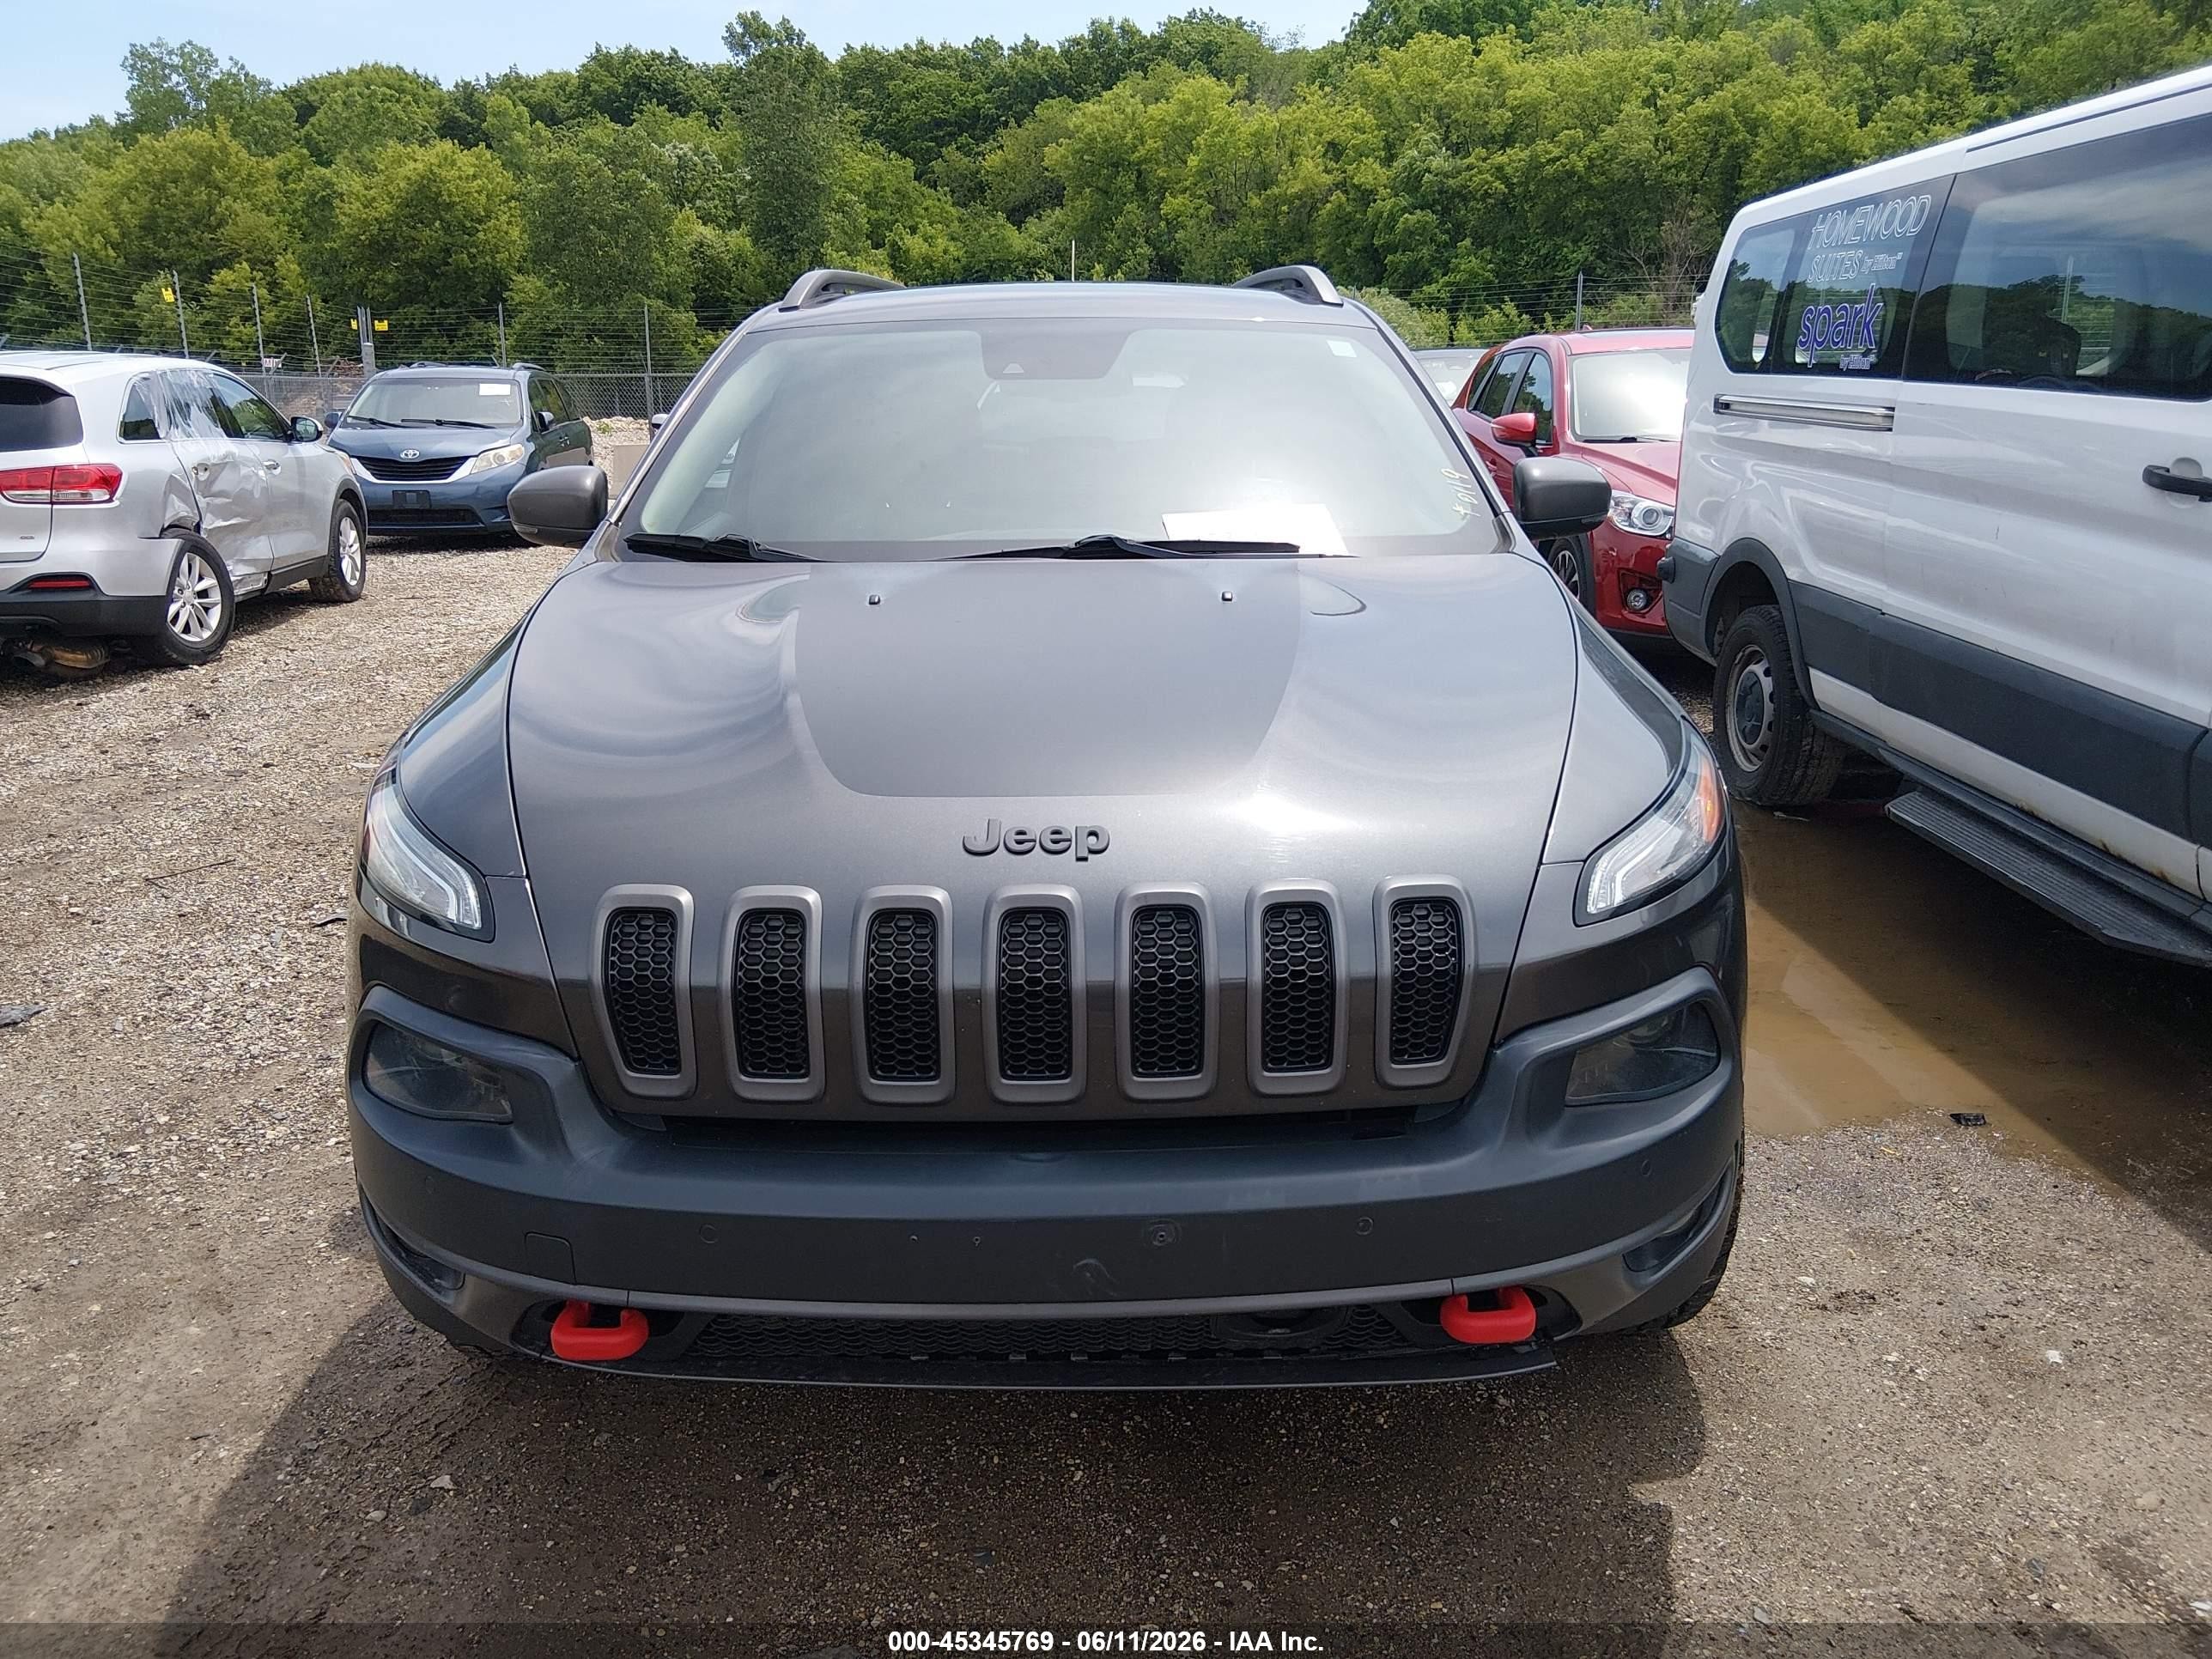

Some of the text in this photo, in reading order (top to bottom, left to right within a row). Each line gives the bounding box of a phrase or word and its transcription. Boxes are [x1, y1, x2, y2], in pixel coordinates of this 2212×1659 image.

[1808, 194, 1931, 251] HOMEWOOD
[1808, 250, 1863, 283] SUITES
[1861, 256, 1874, 274] by
[1797, 283, 1884, 368] spark
[1839, 354, 1850, 371] by
[963, 817, 1110, 862] Jeep
